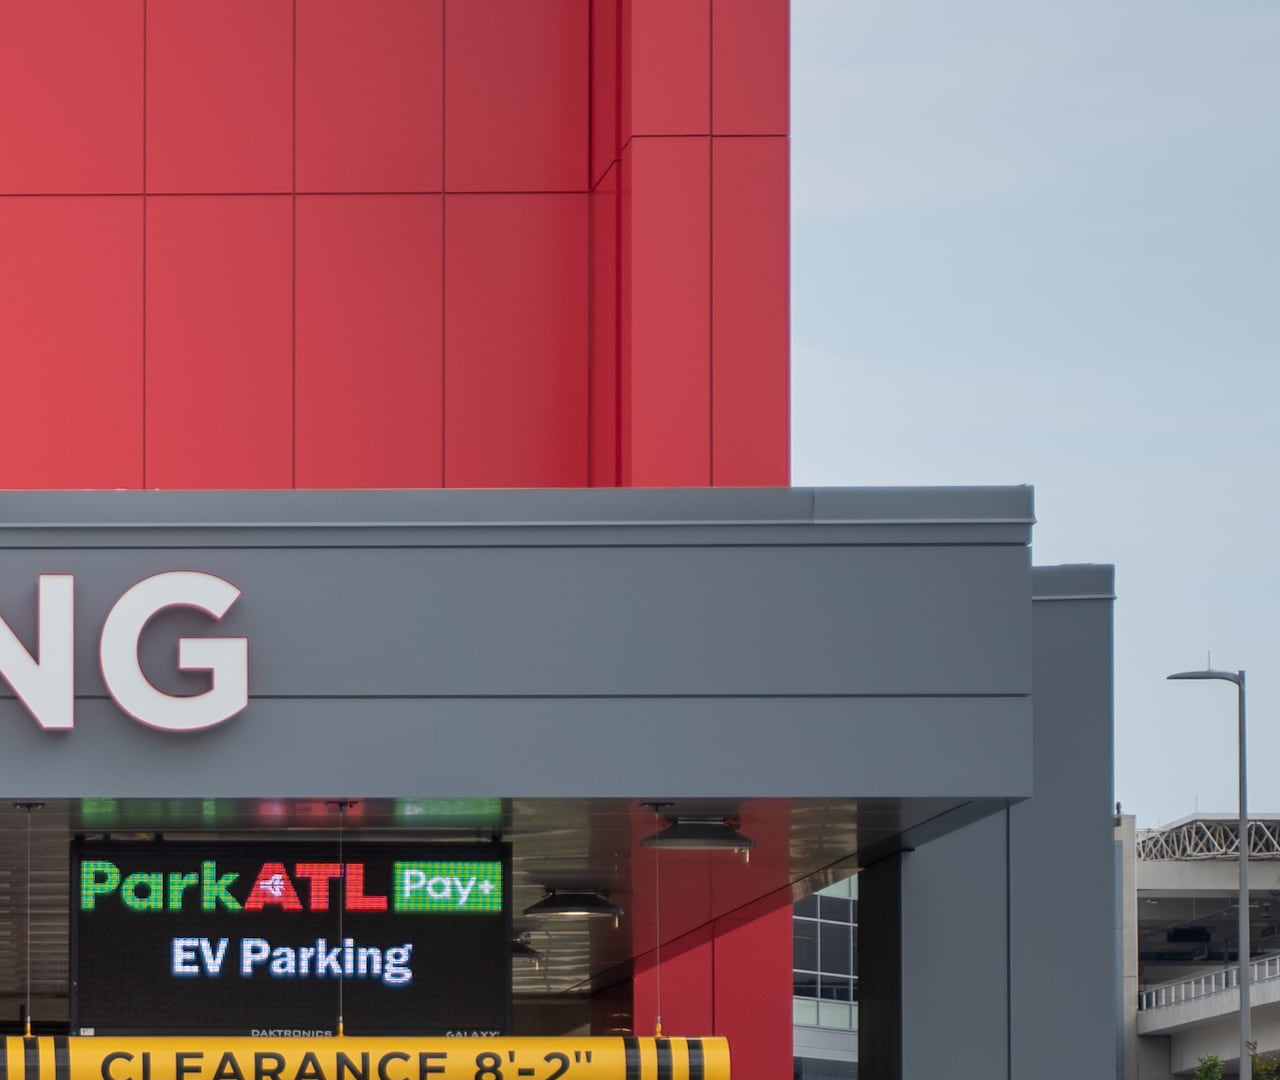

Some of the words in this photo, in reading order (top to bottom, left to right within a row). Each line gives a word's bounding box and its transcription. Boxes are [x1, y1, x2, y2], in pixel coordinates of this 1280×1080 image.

[80, 861, 389, 911] ParkATL
[403, 869, 493, 904] Pay+
[171, 937, 230, 976] EV
[241, 937, 414, 984] Parking
[251, 1029, 333, 1038] DAKTRONICS
